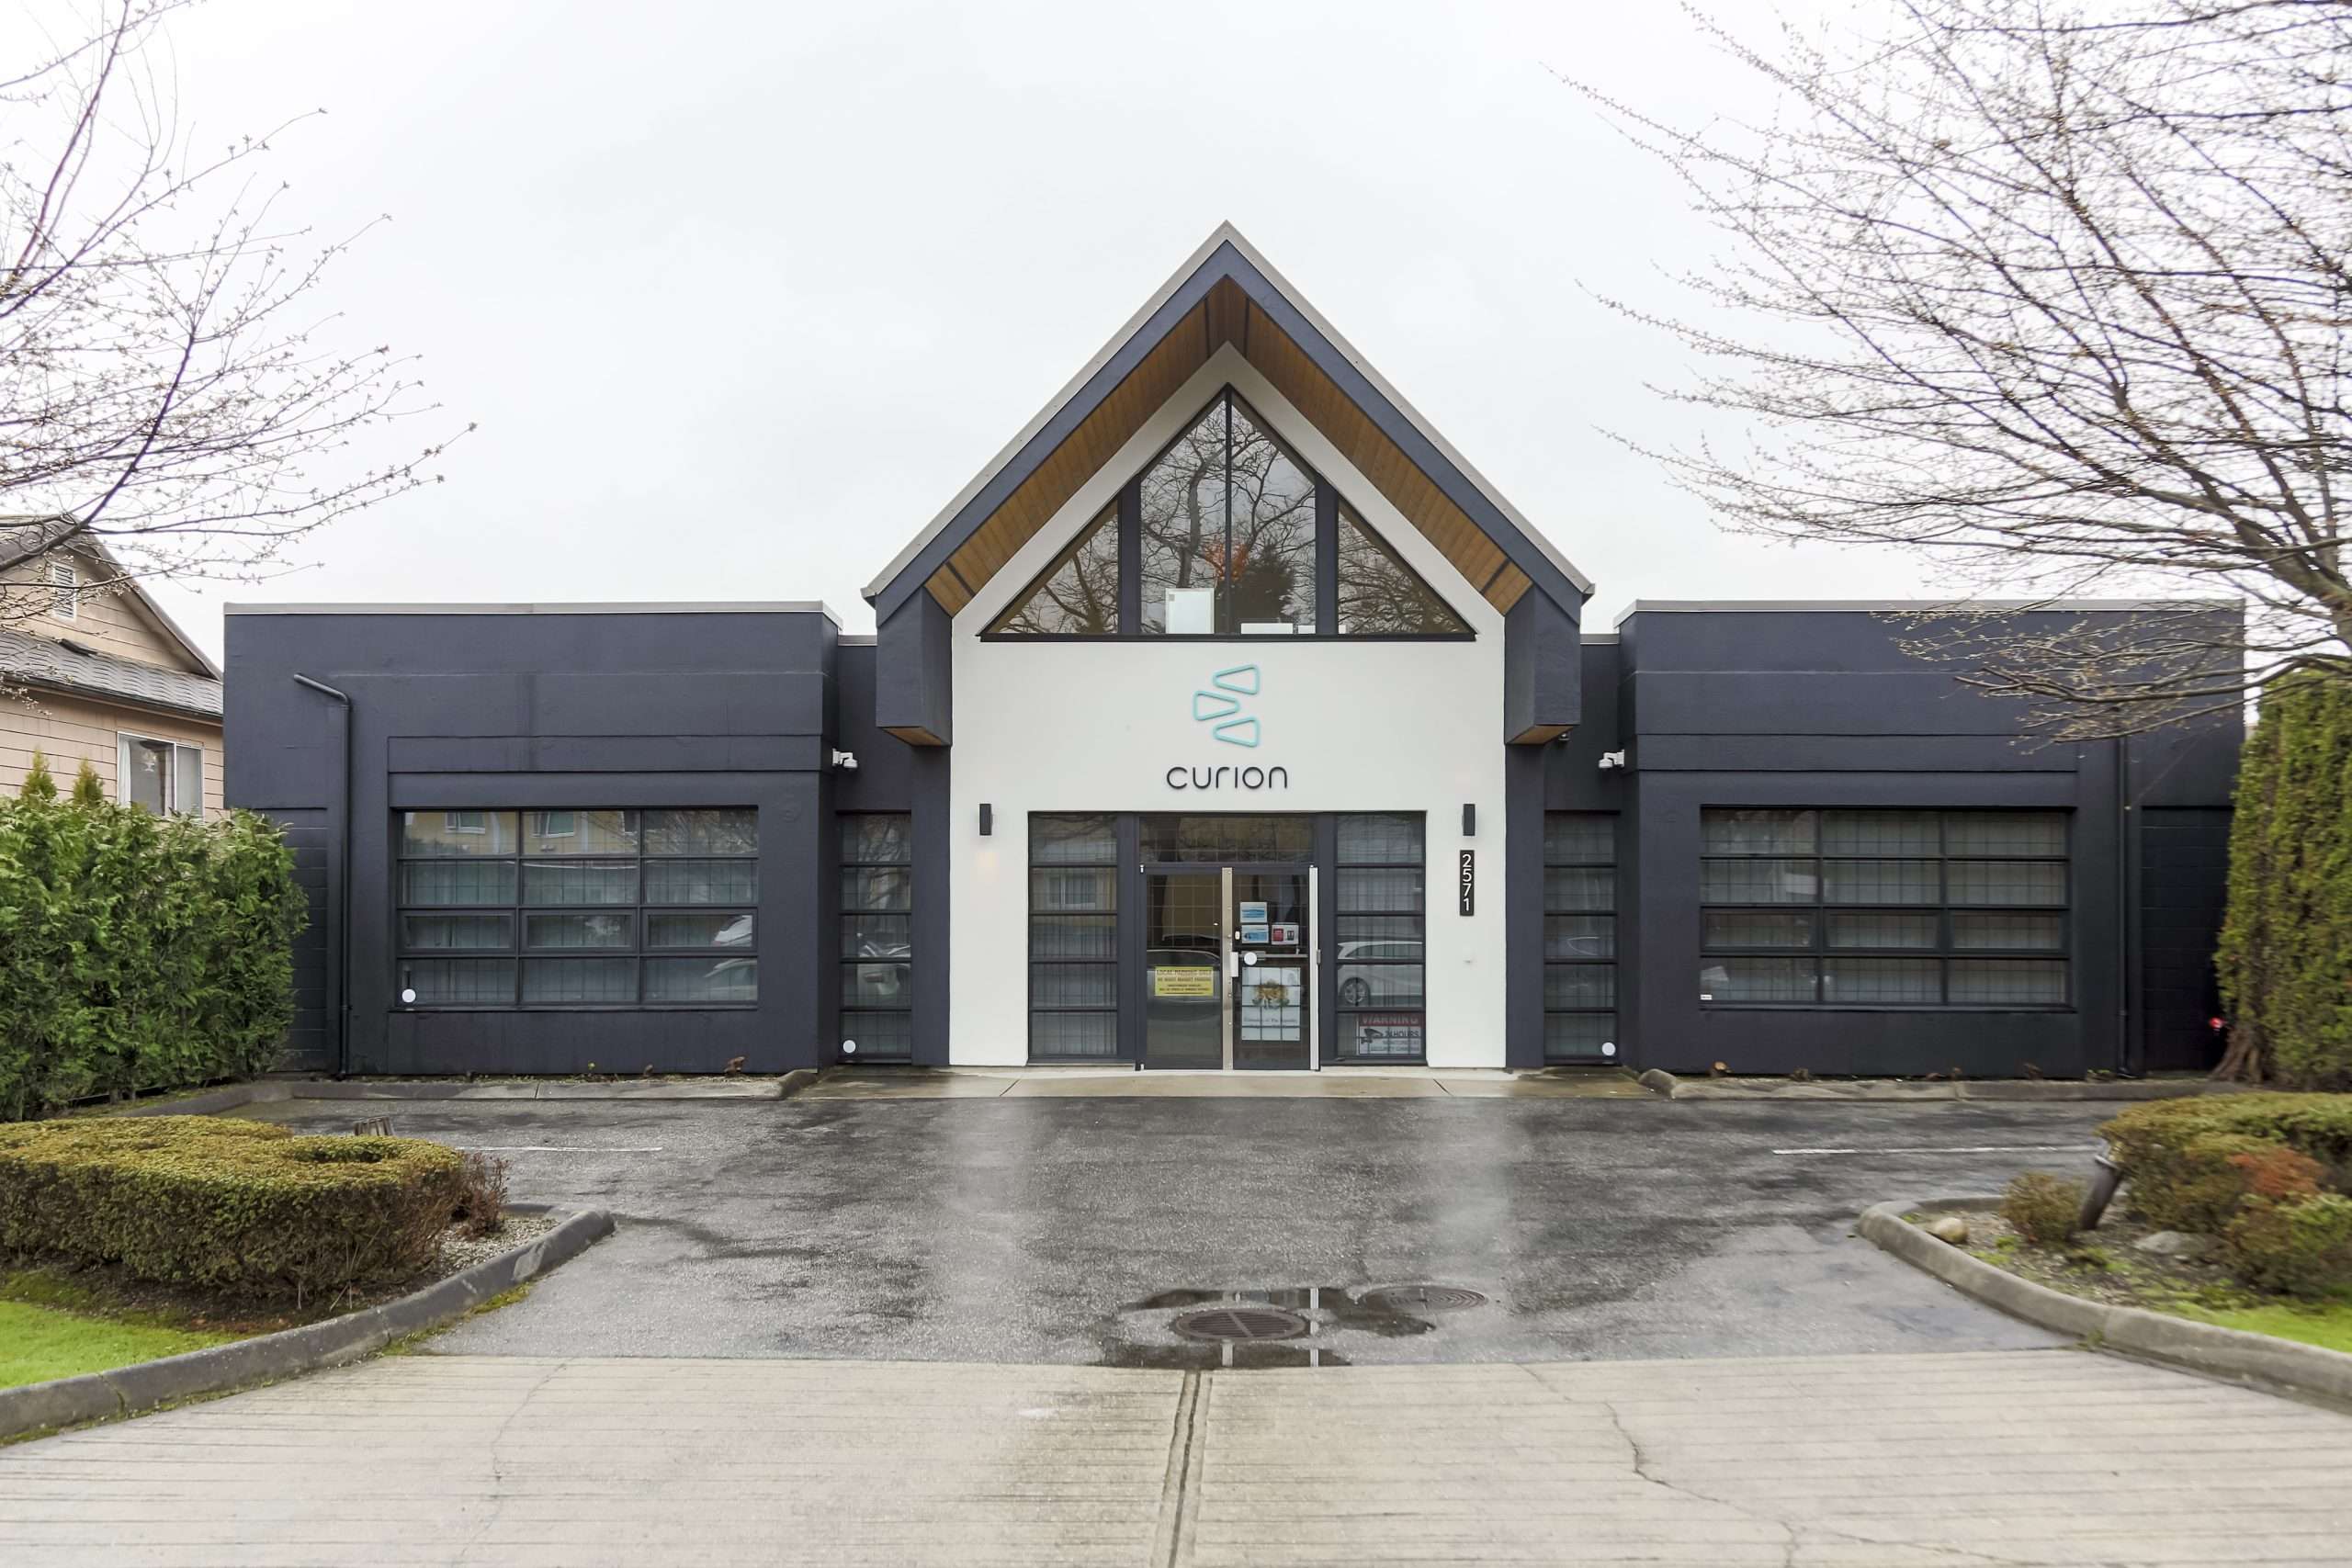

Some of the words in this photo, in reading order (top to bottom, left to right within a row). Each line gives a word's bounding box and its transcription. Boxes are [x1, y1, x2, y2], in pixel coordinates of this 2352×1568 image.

[1166, 766, 1288, 790] curion
[1462, 853, 1472, 911] 2571
[1363, 1014, 1419, 1024] WARNING
